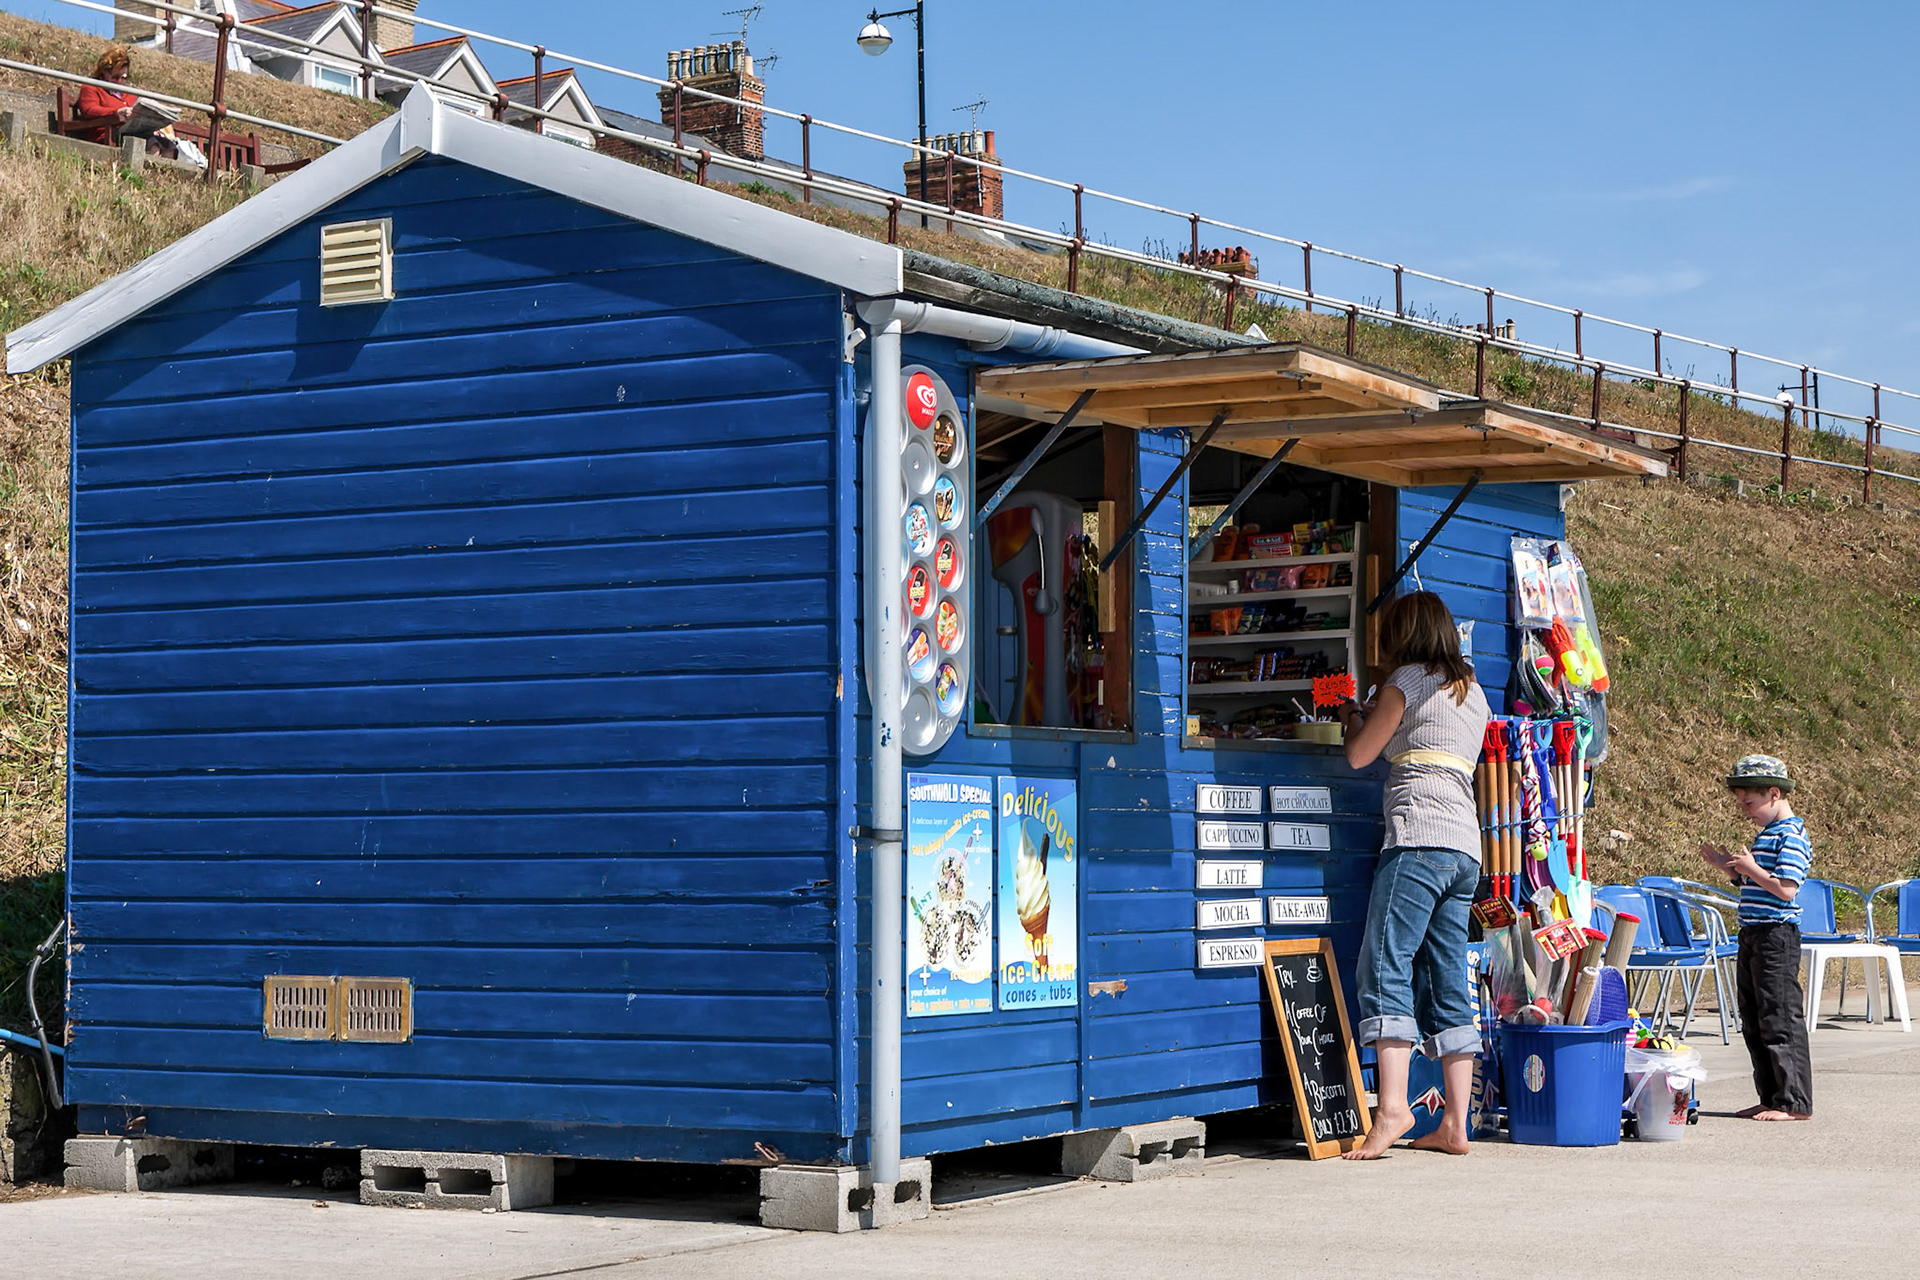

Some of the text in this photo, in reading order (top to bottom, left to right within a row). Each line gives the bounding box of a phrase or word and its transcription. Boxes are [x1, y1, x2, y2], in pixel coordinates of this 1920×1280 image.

[909, 782, 992, 805] SOUTHWOLD SPECIAL
[1209, 789, 1254, 810] COFFEE
[1276, 797, 1330, 809] HOT CHOCOLATE
[1002, 786, 1075, 864] Delicious
[1205, 828, 1260, 844] CAPPUCCINO
[1290, 827, 1312, 846] TEA
[1214, 904, 1250, 923] MOCHA
[1276, 902, 1326, 919] TAKE-AWAY
[1024, 933, 1054, 958] Soft
[1209, 943, 1257, 962] ESPRESSO
[1001, 959, 1076, 986] Ice-Cream
[1005, 988, 1037, 1004] cones
[1049, 984, 1072, 1001] tubs
[1291, 1001, 1315, 1029] COFFEE
[1314, 1003, 1327, 1024] OF
[1312, 1026, 1335, 1056] CHOICE
[1310, 1079, 1346, 1113] BISCOTTI
